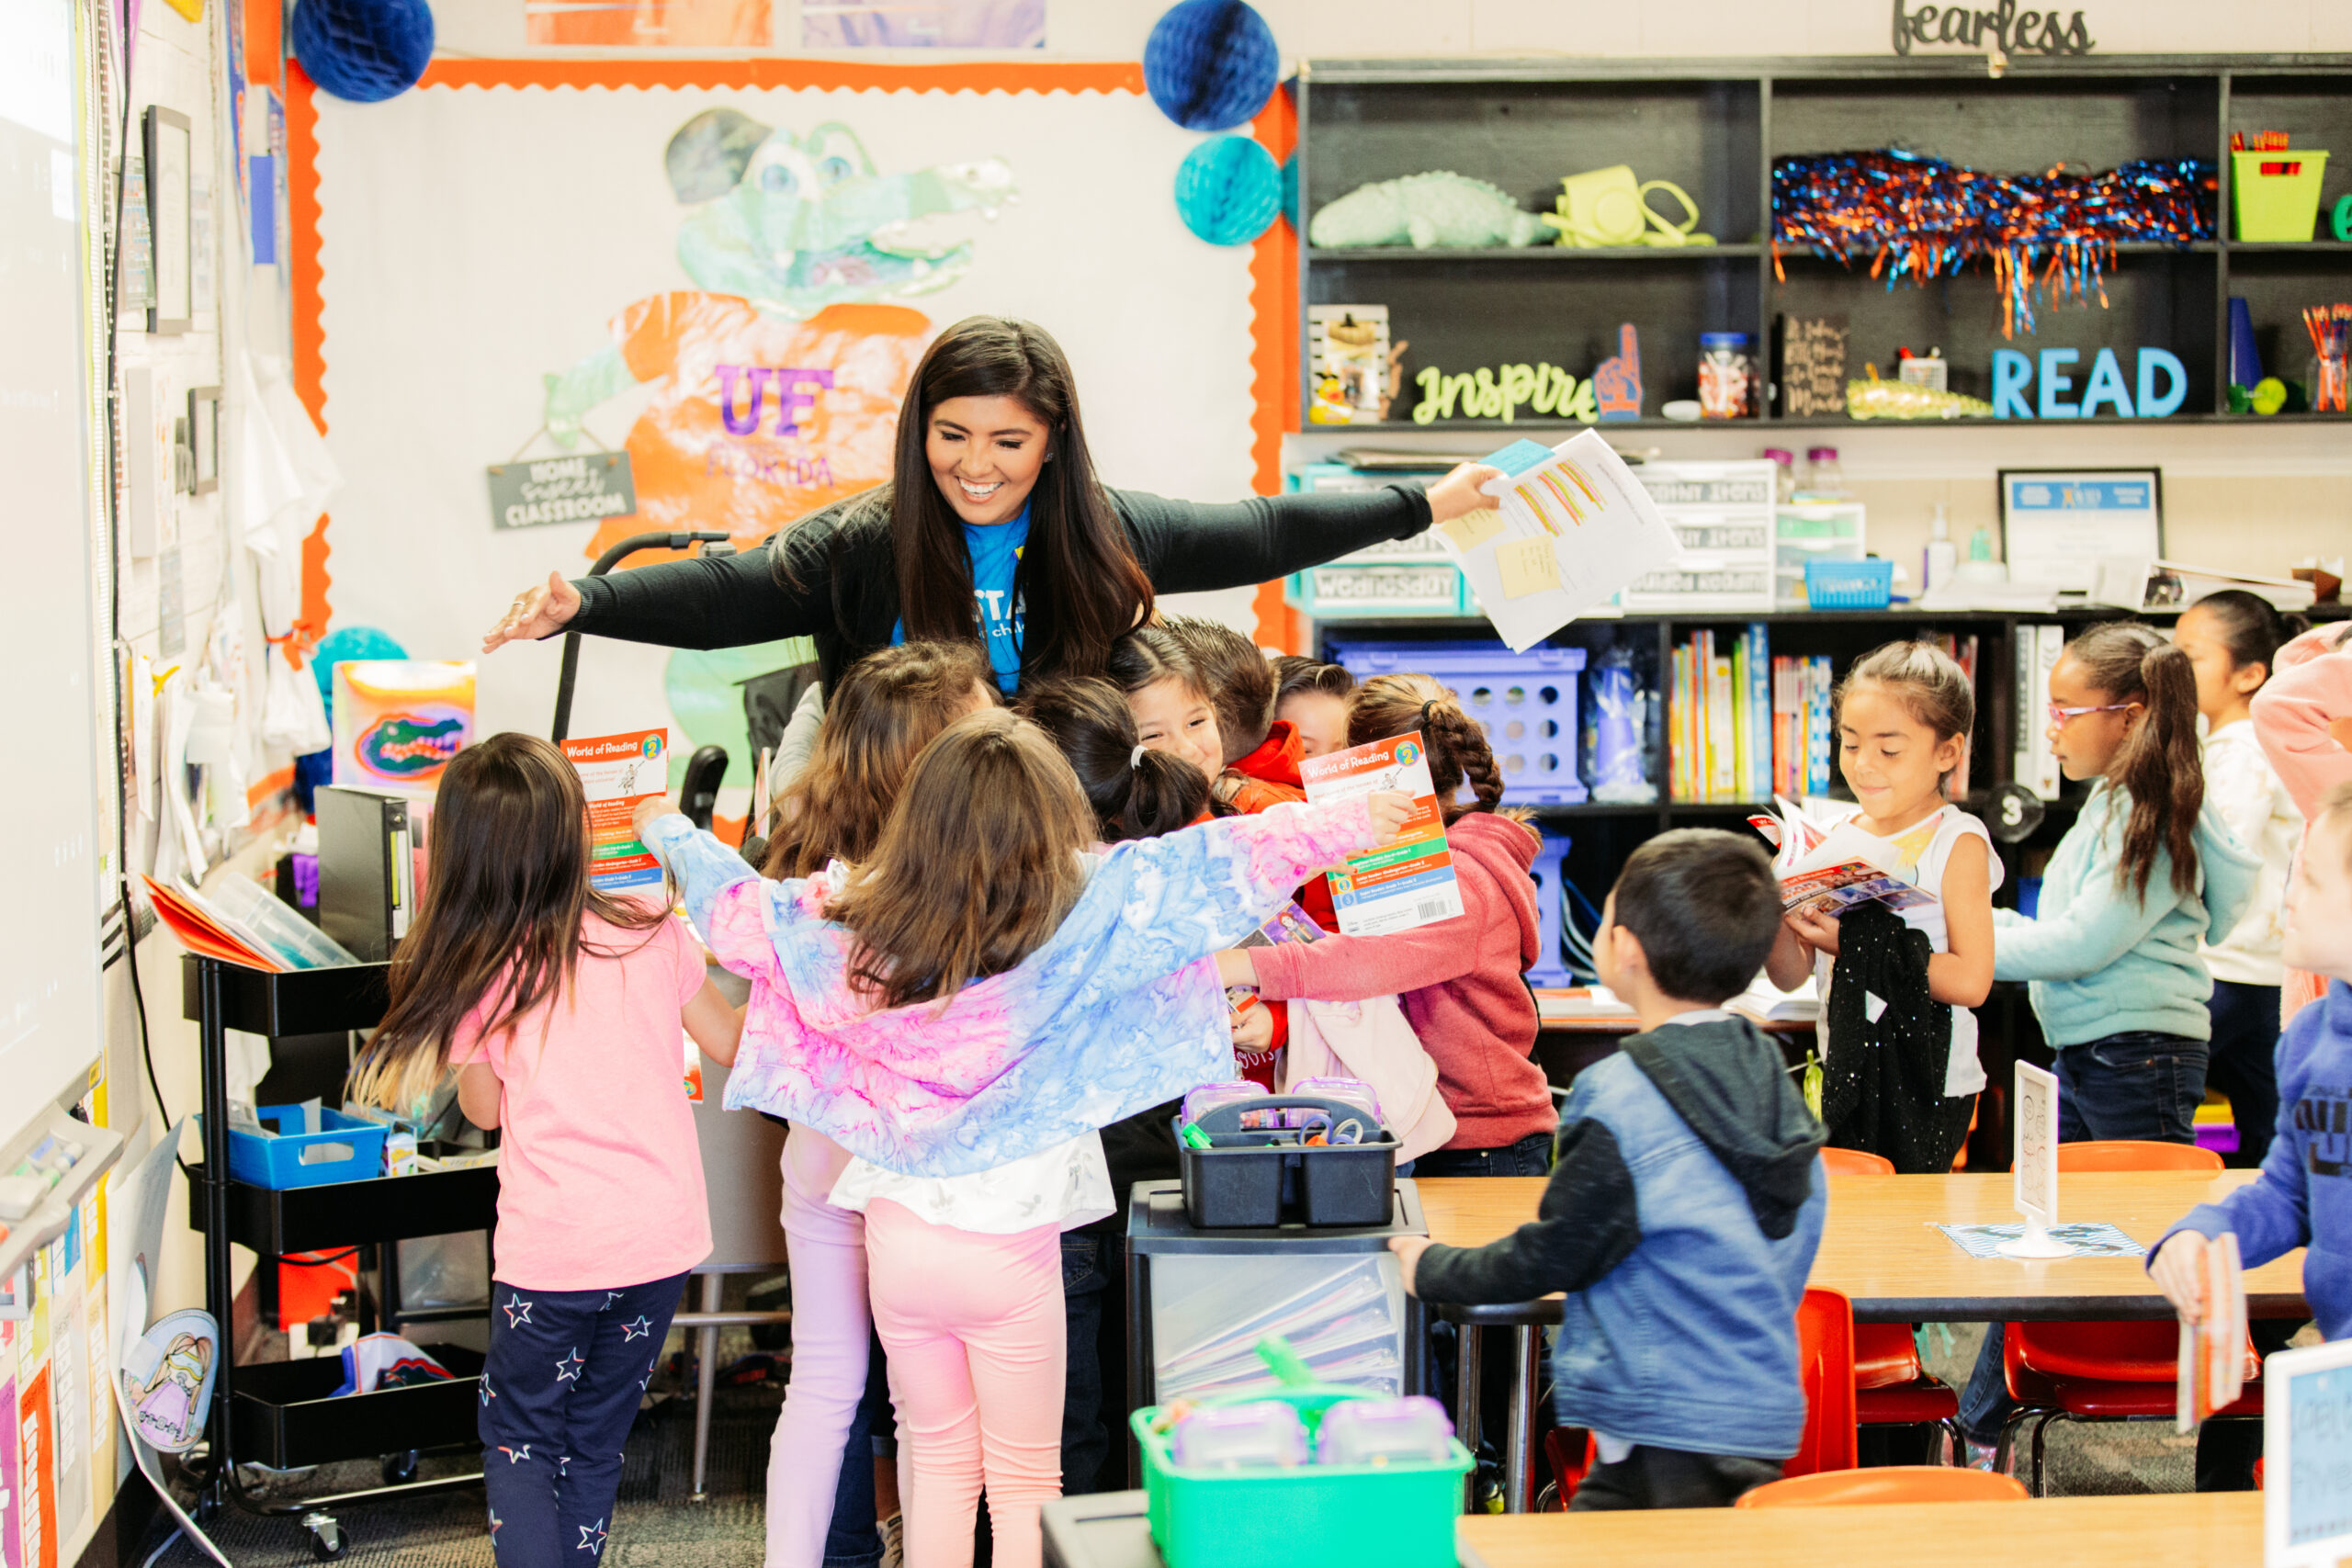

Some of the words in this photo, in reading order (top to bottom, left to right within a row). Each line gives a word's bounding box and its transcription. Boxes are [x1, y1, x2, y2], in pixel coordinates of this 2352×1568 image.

[1893, 0, 2096, 56] fearless
[1993, 347, 2188, 419] READ
[715, 365, 834, 436] UF
[707, 452, 834, 488] FLORIDA
[505, 491, 628, 527] CLASSROOM
[567, 746, 594, 758] World
[595, 743, 605, 755] of
[605, 741, 638, 753] Reading
[648, 741, 657, 758] 2
[1307, 764, 1338, 778] World
[1340, 760, 1351, 771] of
[1351, 750, 1390, 768] Reading
[1402, 748, 1414, 765] 2
[2002, 795, 2022, 826] 3
